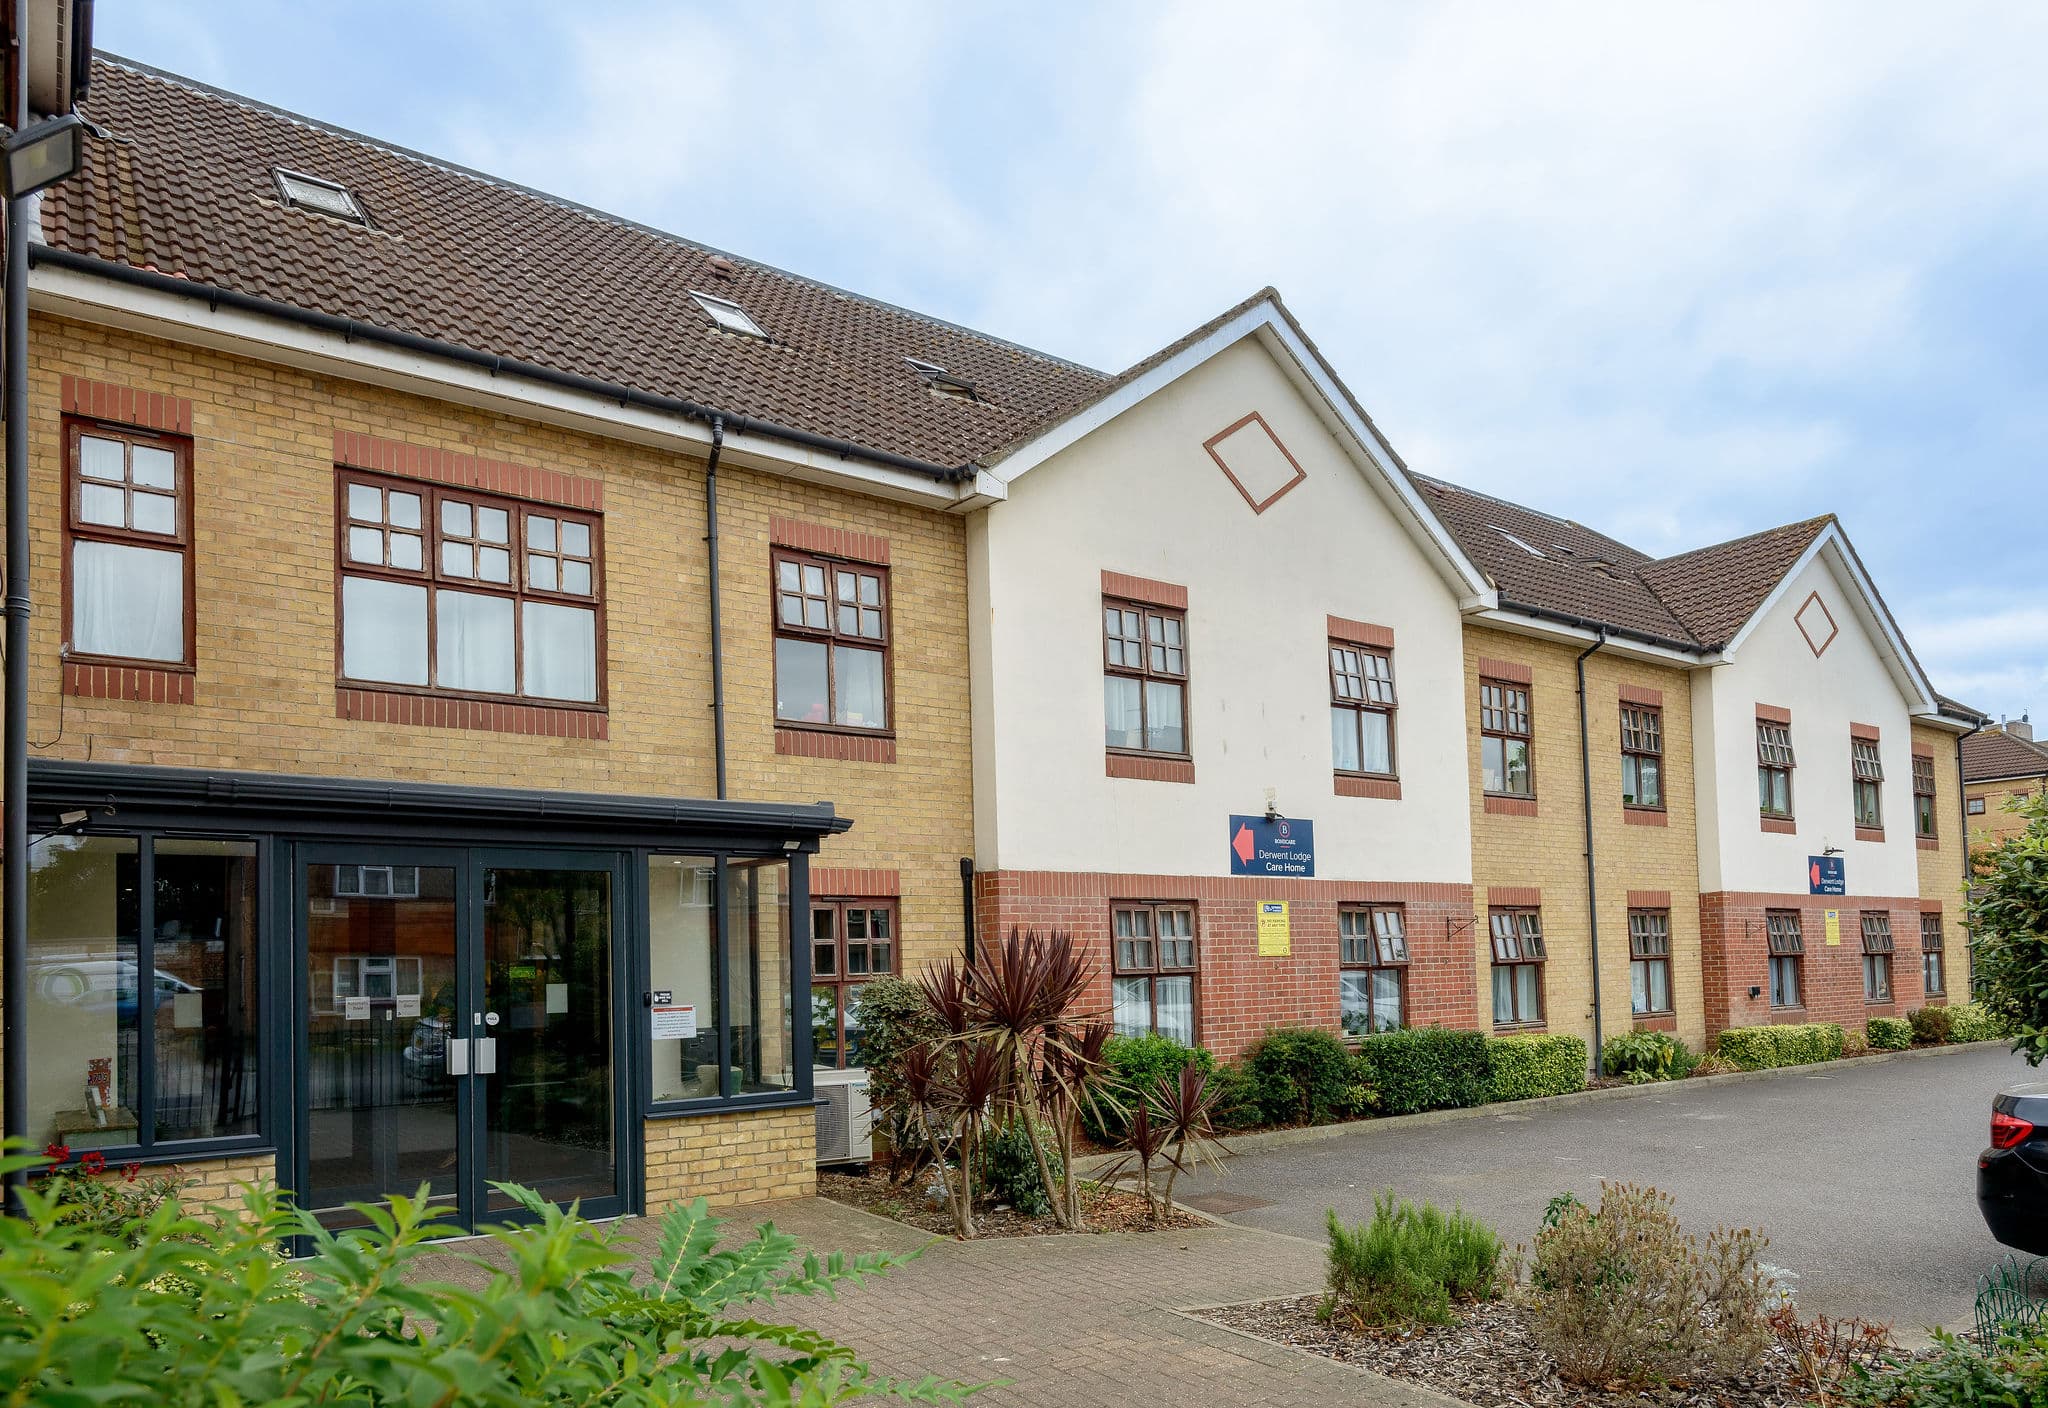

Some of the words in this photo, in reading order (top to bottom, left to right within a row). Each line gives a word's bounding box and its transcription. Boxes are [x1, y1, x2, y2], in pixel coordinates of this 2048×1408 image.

[1282, 825, 1288, 834] B
[1259, 849, 1289, 860] Derwent
[1289, 852, 1312, 863] Lodge
[1265, 862, 1283, 871] Care
[1284, 862, 1306, 873] Home
